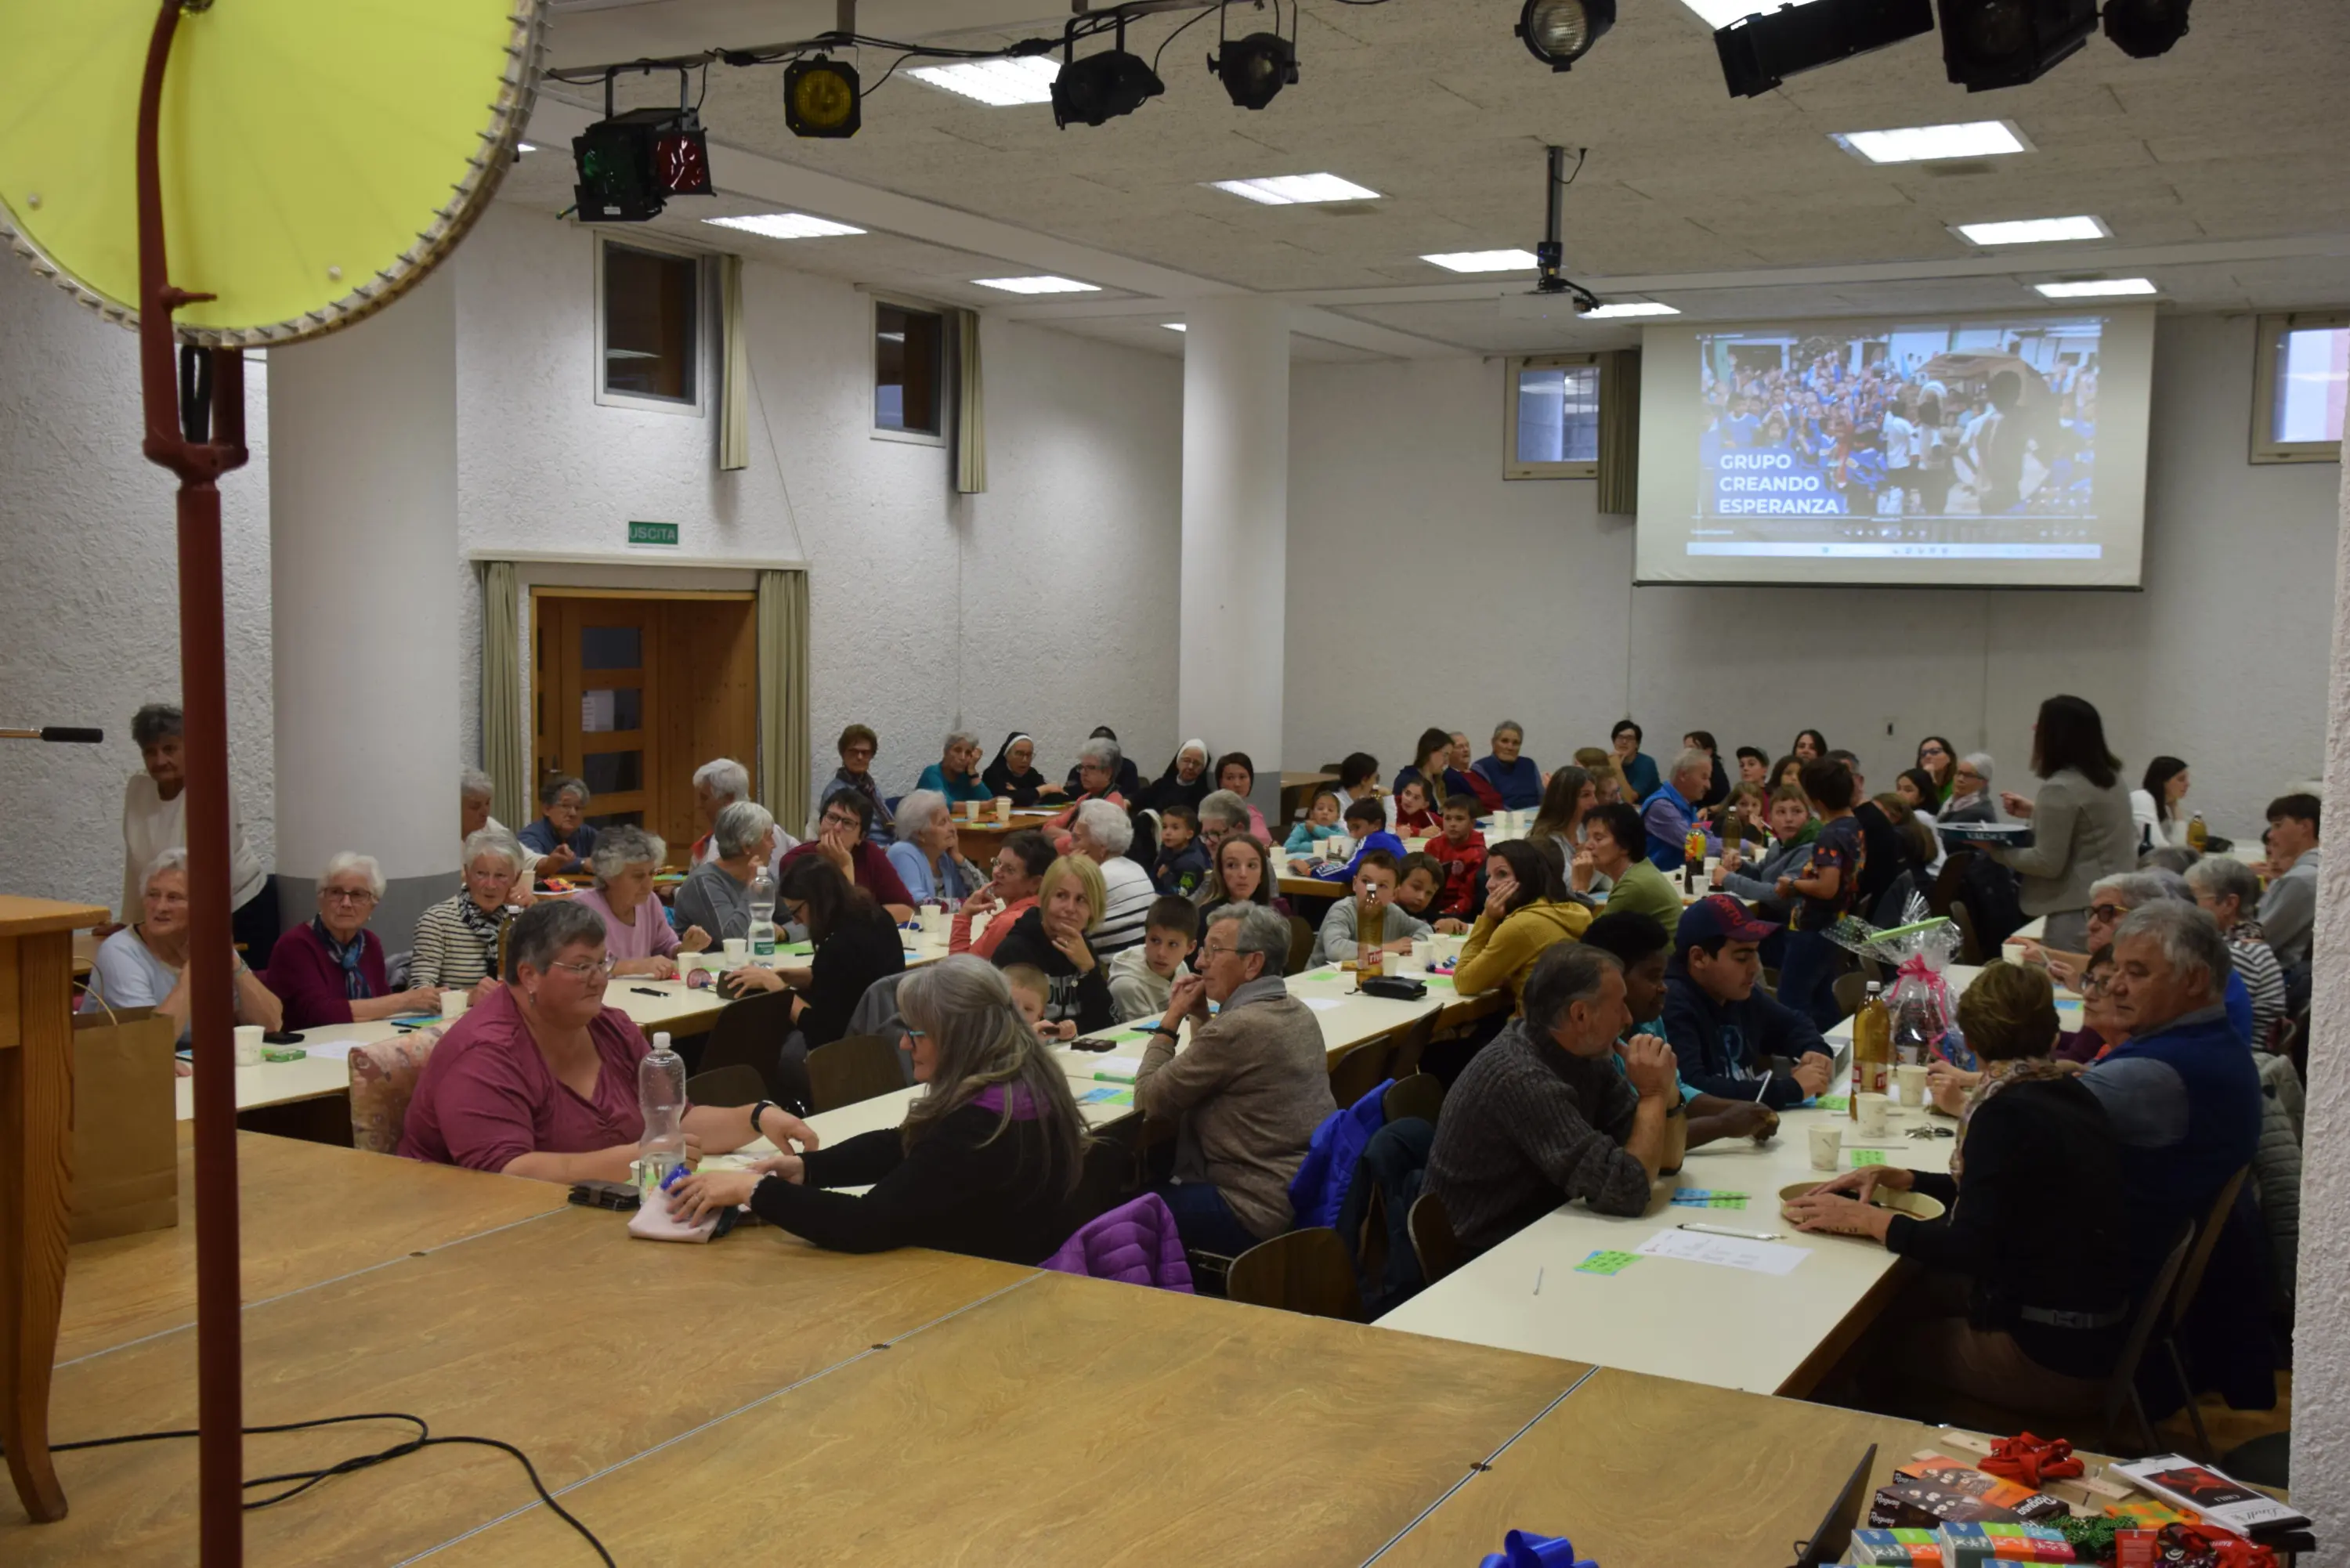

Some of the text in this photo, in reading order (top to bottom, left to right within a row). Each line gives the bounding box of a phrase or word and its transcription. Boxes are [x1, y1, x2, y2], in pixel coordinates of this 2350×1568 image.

[1719, 453, 1792, 470] GRUPO
[1719, 475, 1820, 492] CREANDO
[1719, 498, 1840, 514] ESPERANZA
[629, 526, 676, 540] USCITA
[1875, 1493, 1900, 1506] Ragusa
[2016, 1494, 2058, 1516] Ragusa
